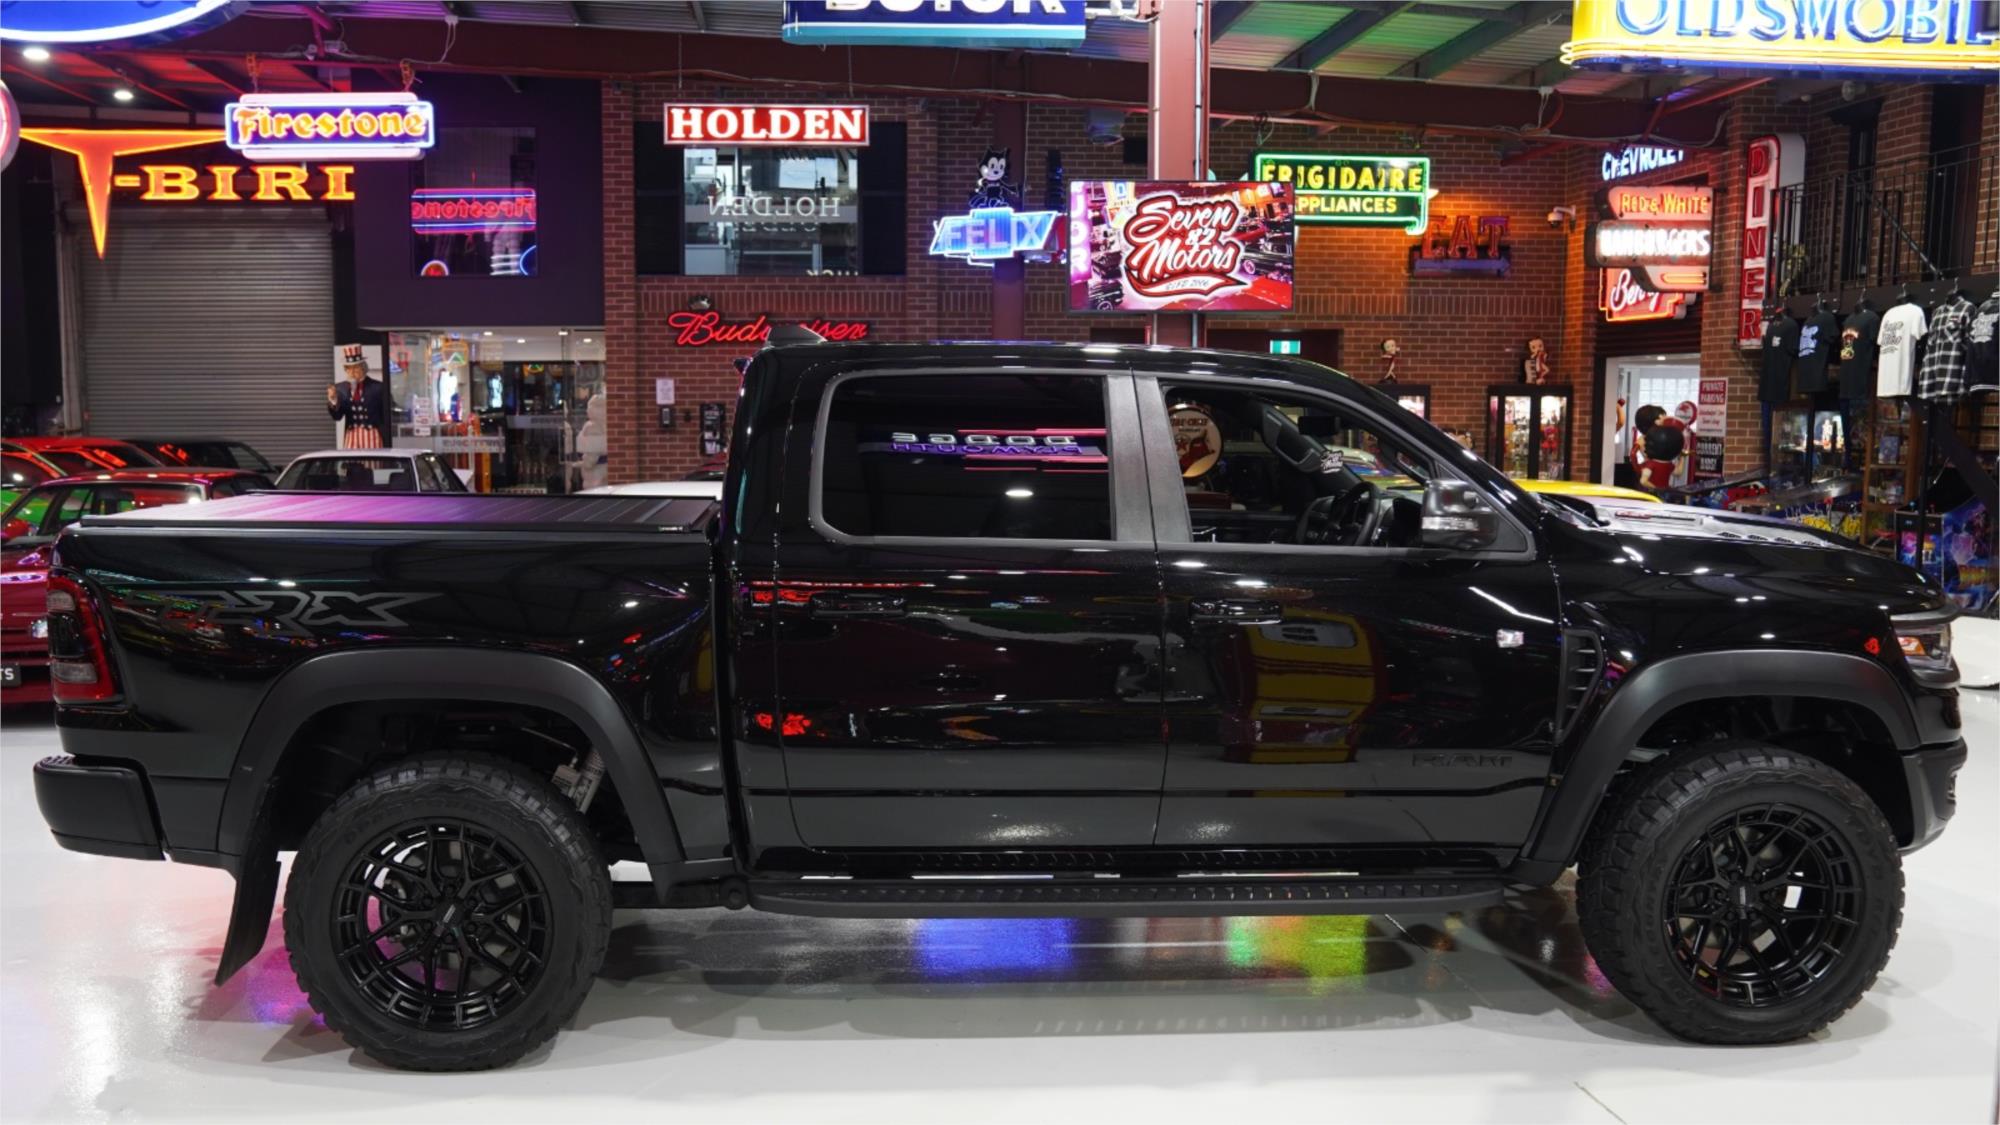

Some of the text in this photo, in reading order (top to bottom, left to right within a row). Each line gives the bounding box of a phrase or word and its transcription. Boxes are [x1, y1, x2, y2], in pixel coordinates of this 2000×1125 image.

[234, 107, 427, 144] Firestone
[670, 108, 864, 140] HOLDEN
[1261, 165, 1424, 192] FRIGIDAIRE
[1130, 197, 1232, 243] Seven
[1621, 193, 1650, 213] RED
[1663, 192, 1709, 215] WHITE
[945, 216, 1044, 250] FELIX
[1185, 228, 1217, 246] 82
[1422, 215, 1511, 260] EAT
[1600, 229, 1711, 256] HAMBURGERS
[1741, 146, 1771, 338] DINER
[1131, 240, 1235, 282] Motors
[667, 311, 868, 346] Budiser
[130, 590, 444, 638] TRX
[1411, 752, 1513, 768] RAM
